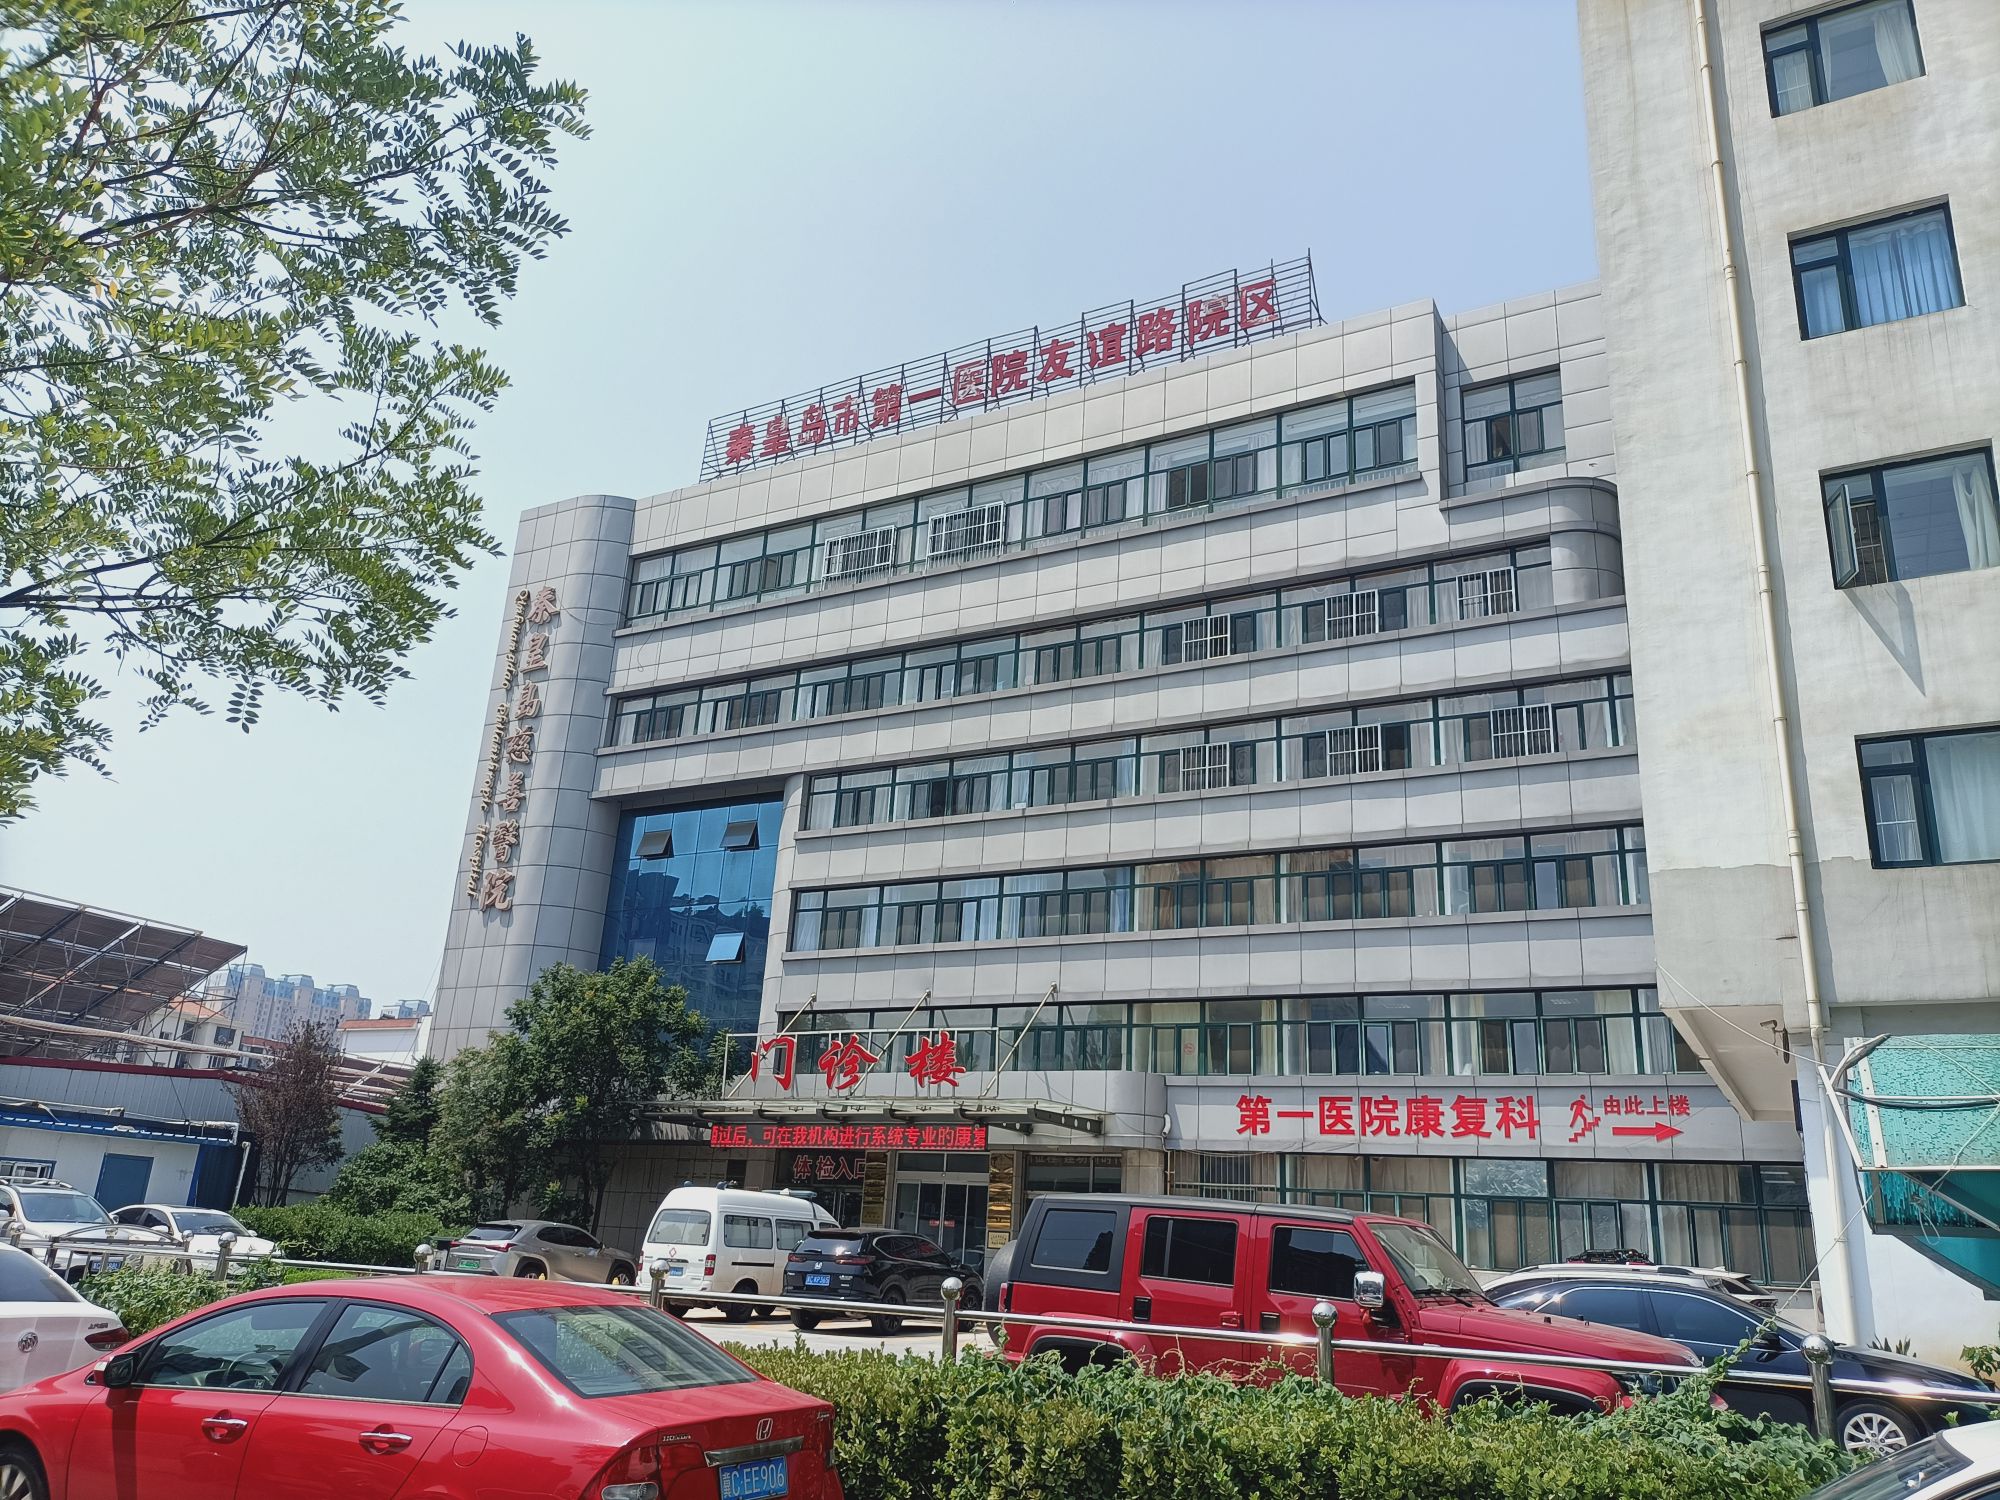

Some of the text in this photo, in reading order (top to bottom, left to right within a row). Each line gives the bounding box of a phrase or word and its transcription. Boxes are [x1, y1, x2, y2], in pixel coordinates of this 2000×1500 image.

[725, 278, 1279, 465] 秦皇岛市第一医院友谊路院区
[501, 588, 530, 690] Qinhuangdao
[466, 824, 489, 899] Hospital
[750, 1031, 966, 1091] 门诊楼
[1235, 1094, 1540, 1139] 第一医院康复科
[1603, 1094, 1690, 1117] 由此上楼
[793, 1155, 865, 1180] 体检入口
